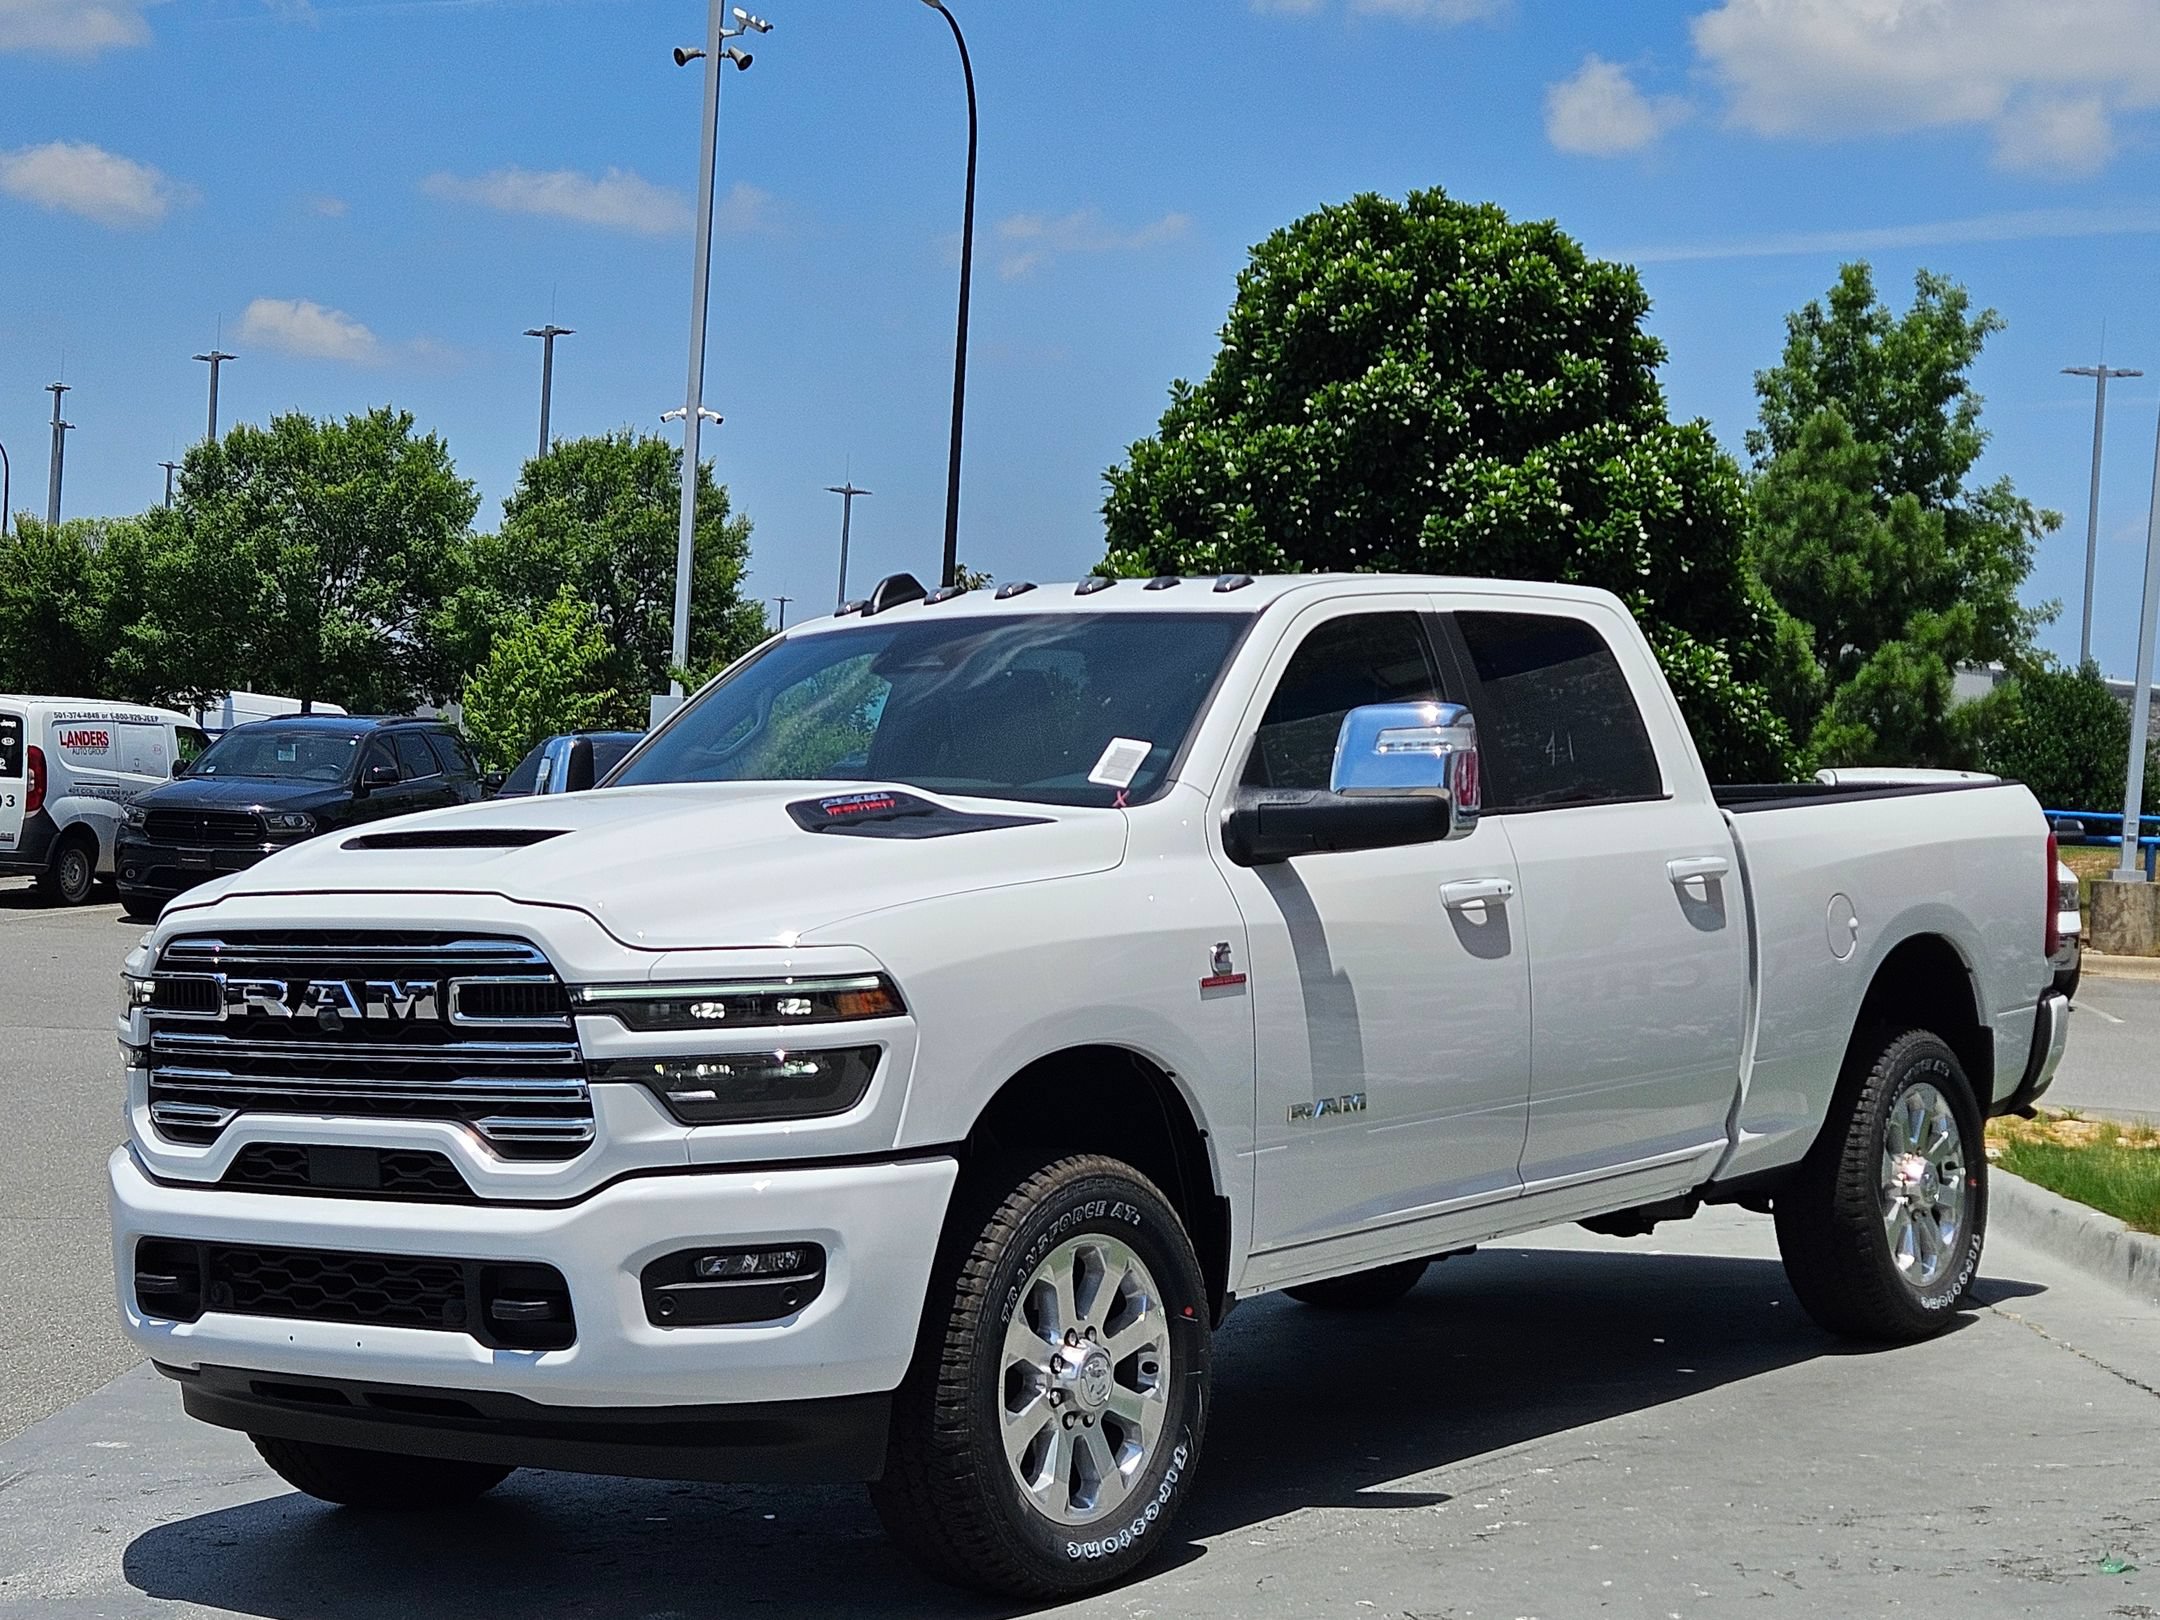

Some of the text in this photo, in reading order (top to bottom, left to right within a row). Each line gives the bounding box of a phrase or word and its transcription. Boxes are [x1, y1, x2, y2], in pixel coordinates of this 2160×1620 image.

[59, 730, 110, 749] LANDERS
[71, 748, 108, 756] AUTO GROUP
[227, 978, 439, 1020] RAM
[1286, 1092, 1367, 1123] RAM
[1000, 1200, 1107, 1324] TRANSFORCE
